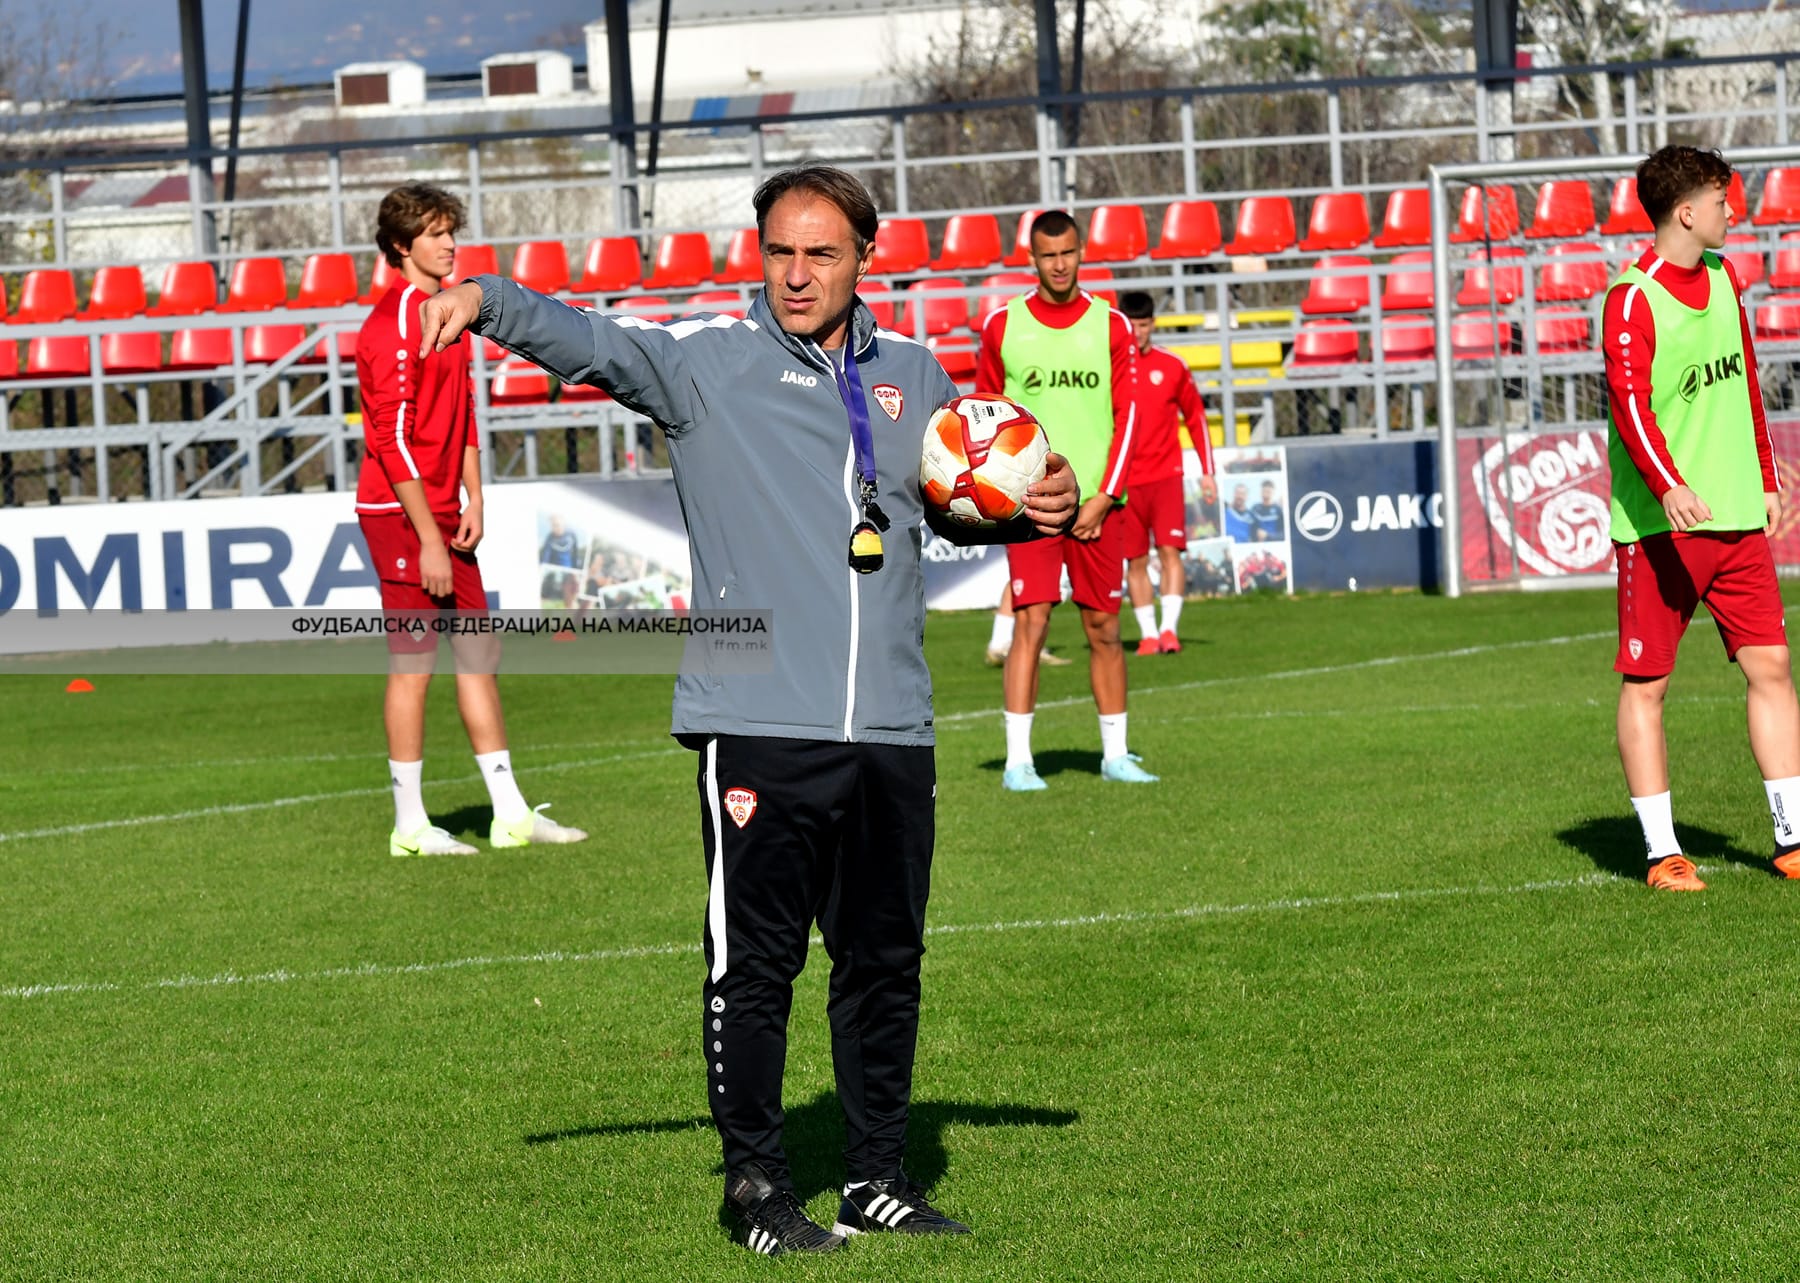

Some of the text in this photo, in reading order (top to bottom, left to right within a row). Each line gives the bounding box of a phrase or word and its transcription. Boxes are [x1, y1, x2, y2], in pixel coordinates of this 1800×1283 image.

[780, 370, 817, 388] JAKO
[1048, 370, 1100, 389] JAKO
[1703, 352, 1743, 387] JAKO
[1497, 431, 1603, 503] ФФМ
[0, 522, 500, 618] MIRA
